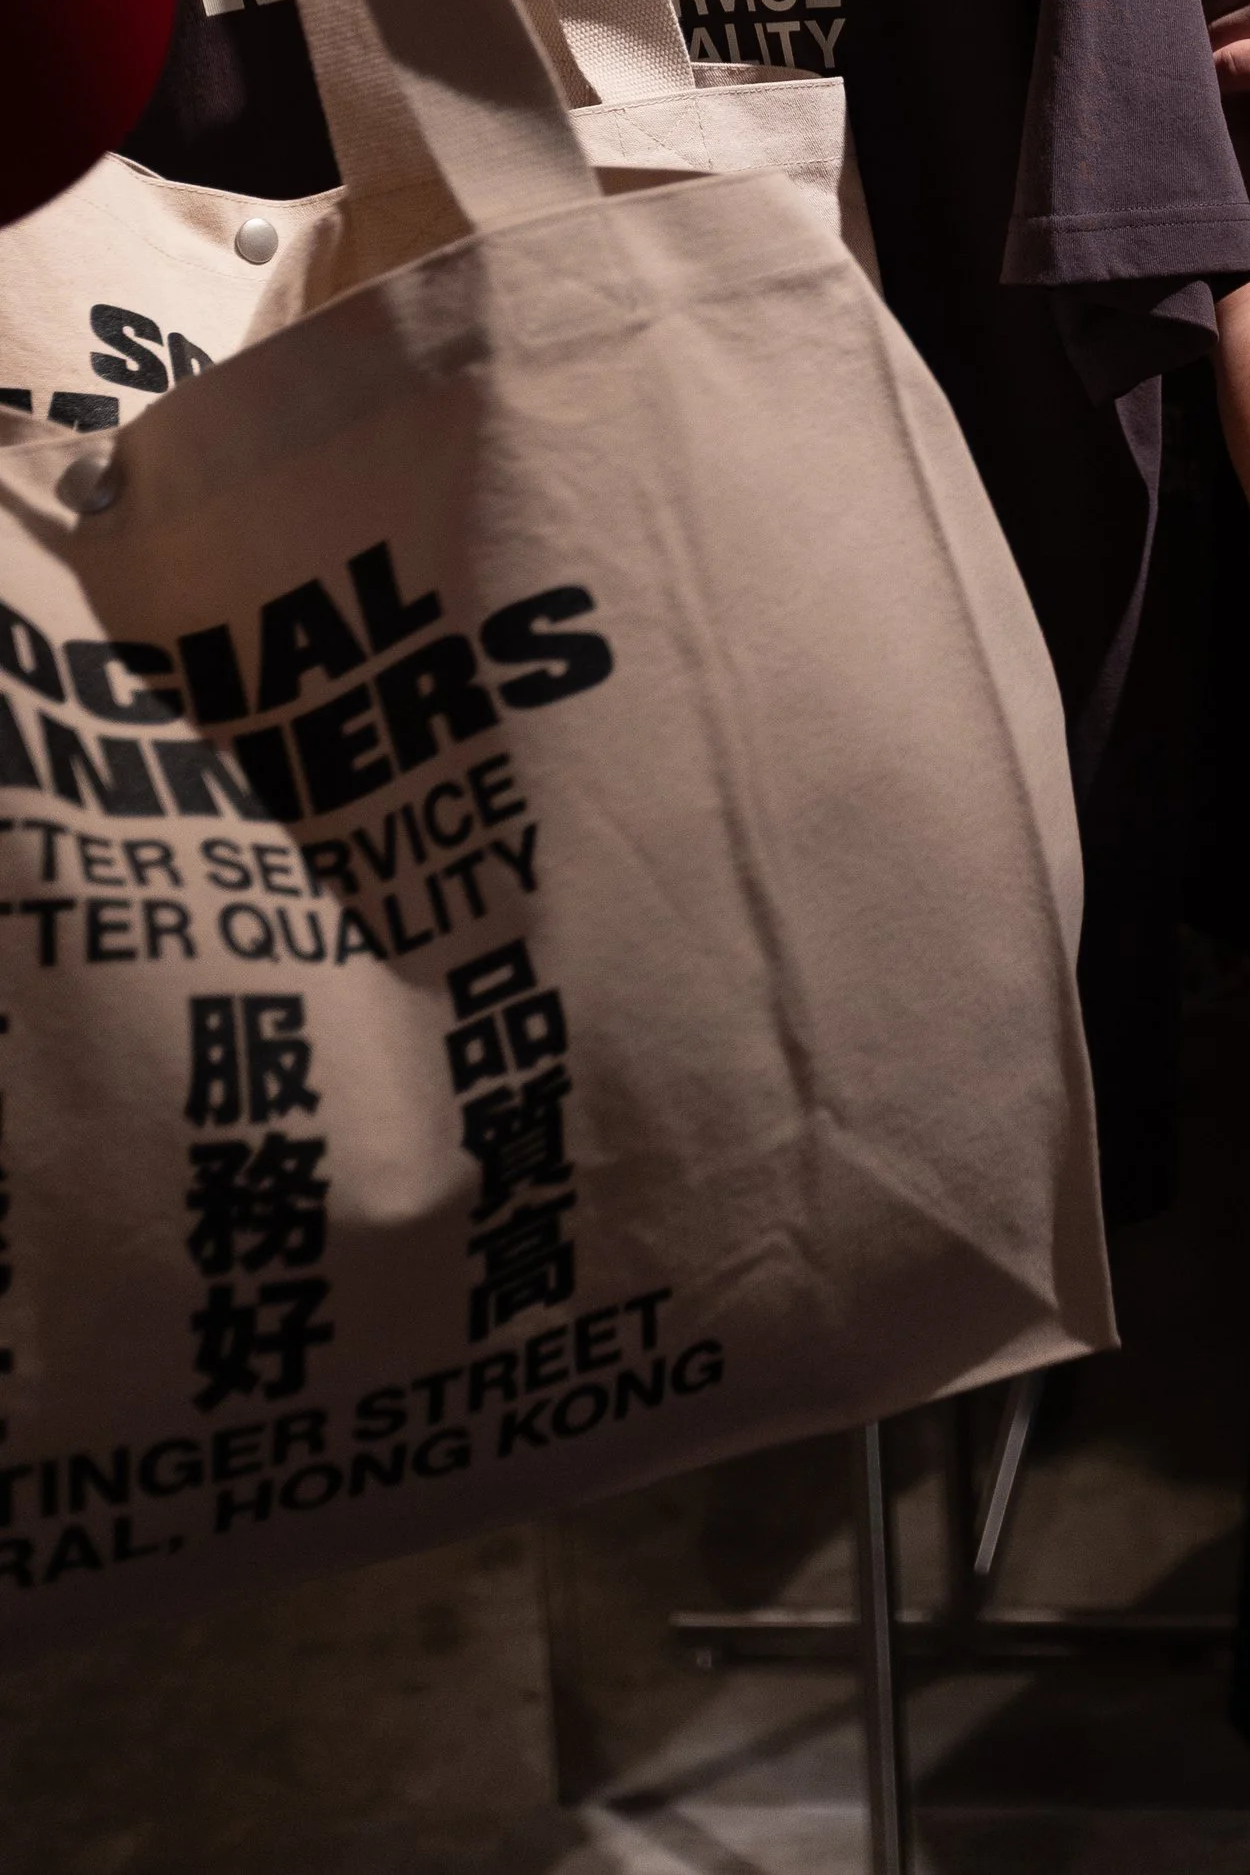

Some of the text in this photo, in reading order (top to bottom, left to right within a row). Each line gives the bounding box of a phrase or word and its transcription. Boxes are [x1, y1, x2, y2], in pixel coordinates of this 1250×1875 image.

[689, 18, 846, 69] ALITY
[203, 752, 528, 898] SERVICE
[219, 823, 538, 967] QUALITY
[184, 992, 336, 1413] 服務好
[446, 937, 578, 1343] 品質高
[214, 1428, 474, 1532] HONG
[496, 1339, 726, 1460] KONG
[354, 1287, 672, 1443] STREET
